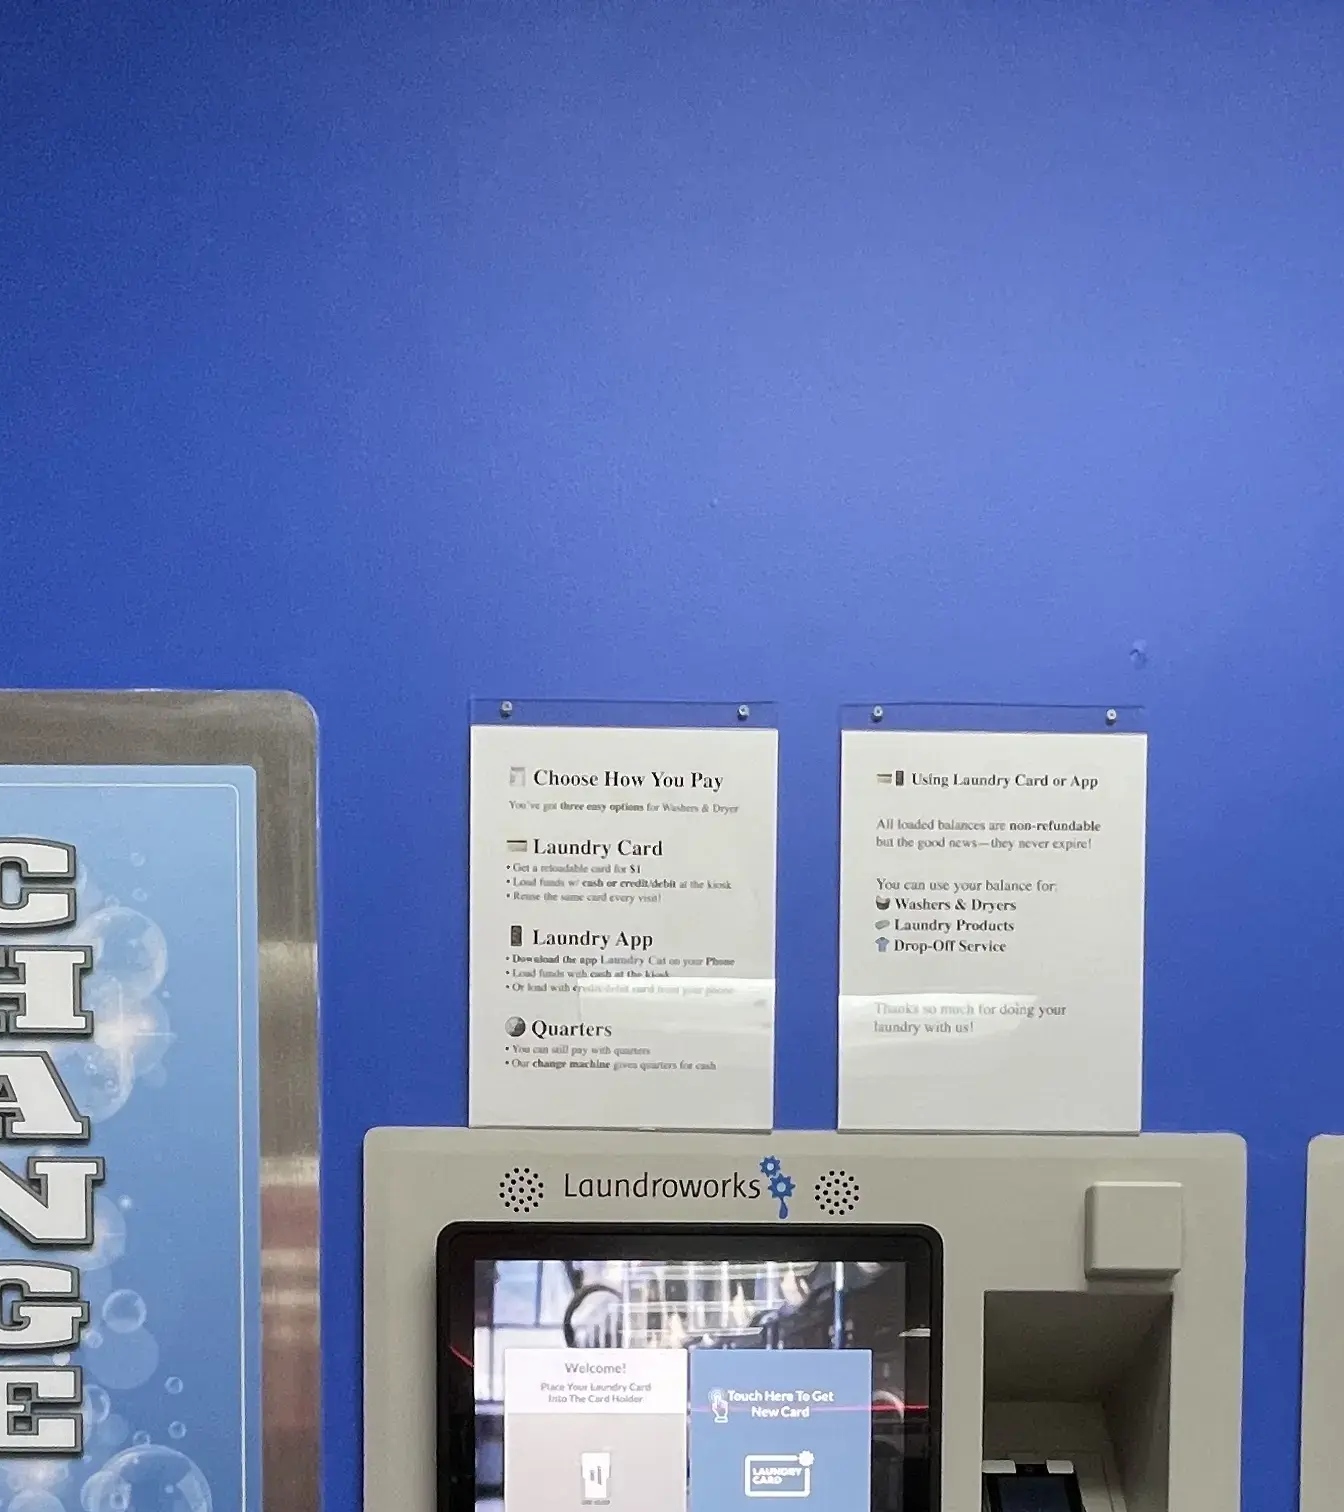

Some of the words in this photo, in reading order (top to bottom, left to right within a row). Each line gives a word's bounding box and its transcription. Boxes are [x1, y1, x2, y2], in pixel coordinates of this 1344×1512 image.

[532, 769, 599, 787] Choose
[604, 770, 643, 787] How
[651, 771, 684, 788] You
[691, 772, 721, 793] Pay
[912, 773, 949, 788] Using
[953, 773, 1010, 789] Laundry
[1014, 773, 1049, 787] Card
[1052, 777, 1068, 787] or
[1071, 775, 1098, 791] App
[876, 818, 894, 830] All
[897, 818, 935, 831] loaded
[937, 819, 986, 831] balances
[988, 822, 1006, 832] are
[1009, 820, 1100, 832] non-refundable
[534, 838, 609, 860] Laundry
[617, 839, 662, 856] Card
[874, 835, 894, 848] but
[896, 836, 915, 848] the
[917, 836, 946, 851] good
[1018, 840, 1050, 849] never
[1051, 837, 1091, 852] expire!
[875, 877, 901, 891] You
[903, 881, 926, 891] can
[929, 881, 950, 891] use
[953, 881, 983, 895] your
[985, 879, 1033, 892] balance
[895, 897, 951, 911] Washers
[954, 899, 966, 911] &
[971, 898, 1016, 914] Dryers
[893, 918, 951, 935] Laundry
[956, 919, 1014, 932] Products
[533, 929, 609, 951] Laundry
[617, 931, 652, 951] App
[893, 938, 957, 955] Drop-Off
[958, 939, 1006, 953] Service
[873, 1001, 920, 1015] Thanks
[922, 1005, 938, 1016] so
[941, 1003, 975, 1016] much
[978, 1003, 996, 1015] for
[999, 1002, 1036, 1019] doing
[1038, 1006, 1066, 1019] your
[530, 1019, 611, 1040] Quarters
[872, 1020, 922, 1036] laundry
[923, 1021, 952, 1033] with
[955, 1020, 973, 1033] us!
[563, 1168, 763, 1200] Laundroworks
[563, 1362, 626, 1374] Welcome!
[539, 1382, 566, 1392] Place
[566, 1382, 589, 1392] Your
[589, 1382, 627, 1393] Laundry
[628, 1382, 651, 1392] Card
[727, 1389, 764, 1403] Touch
[764, 1390, 794, 1403] Here
[793, 1390, 811, 1402] To
[810, 1390, 834, 1403] Get
[570, 1393, 586, 1404] The
[587, 1394, 610, 1403] Card
[611, 1394, 644, 1403] Holder
[751, 1405, 779, 1418] New
[780, 1405, 809, 1418] Card
[751, 1467, 803, 1476] LAUNDRY
[751, 1475, 784, 1485] CARD
